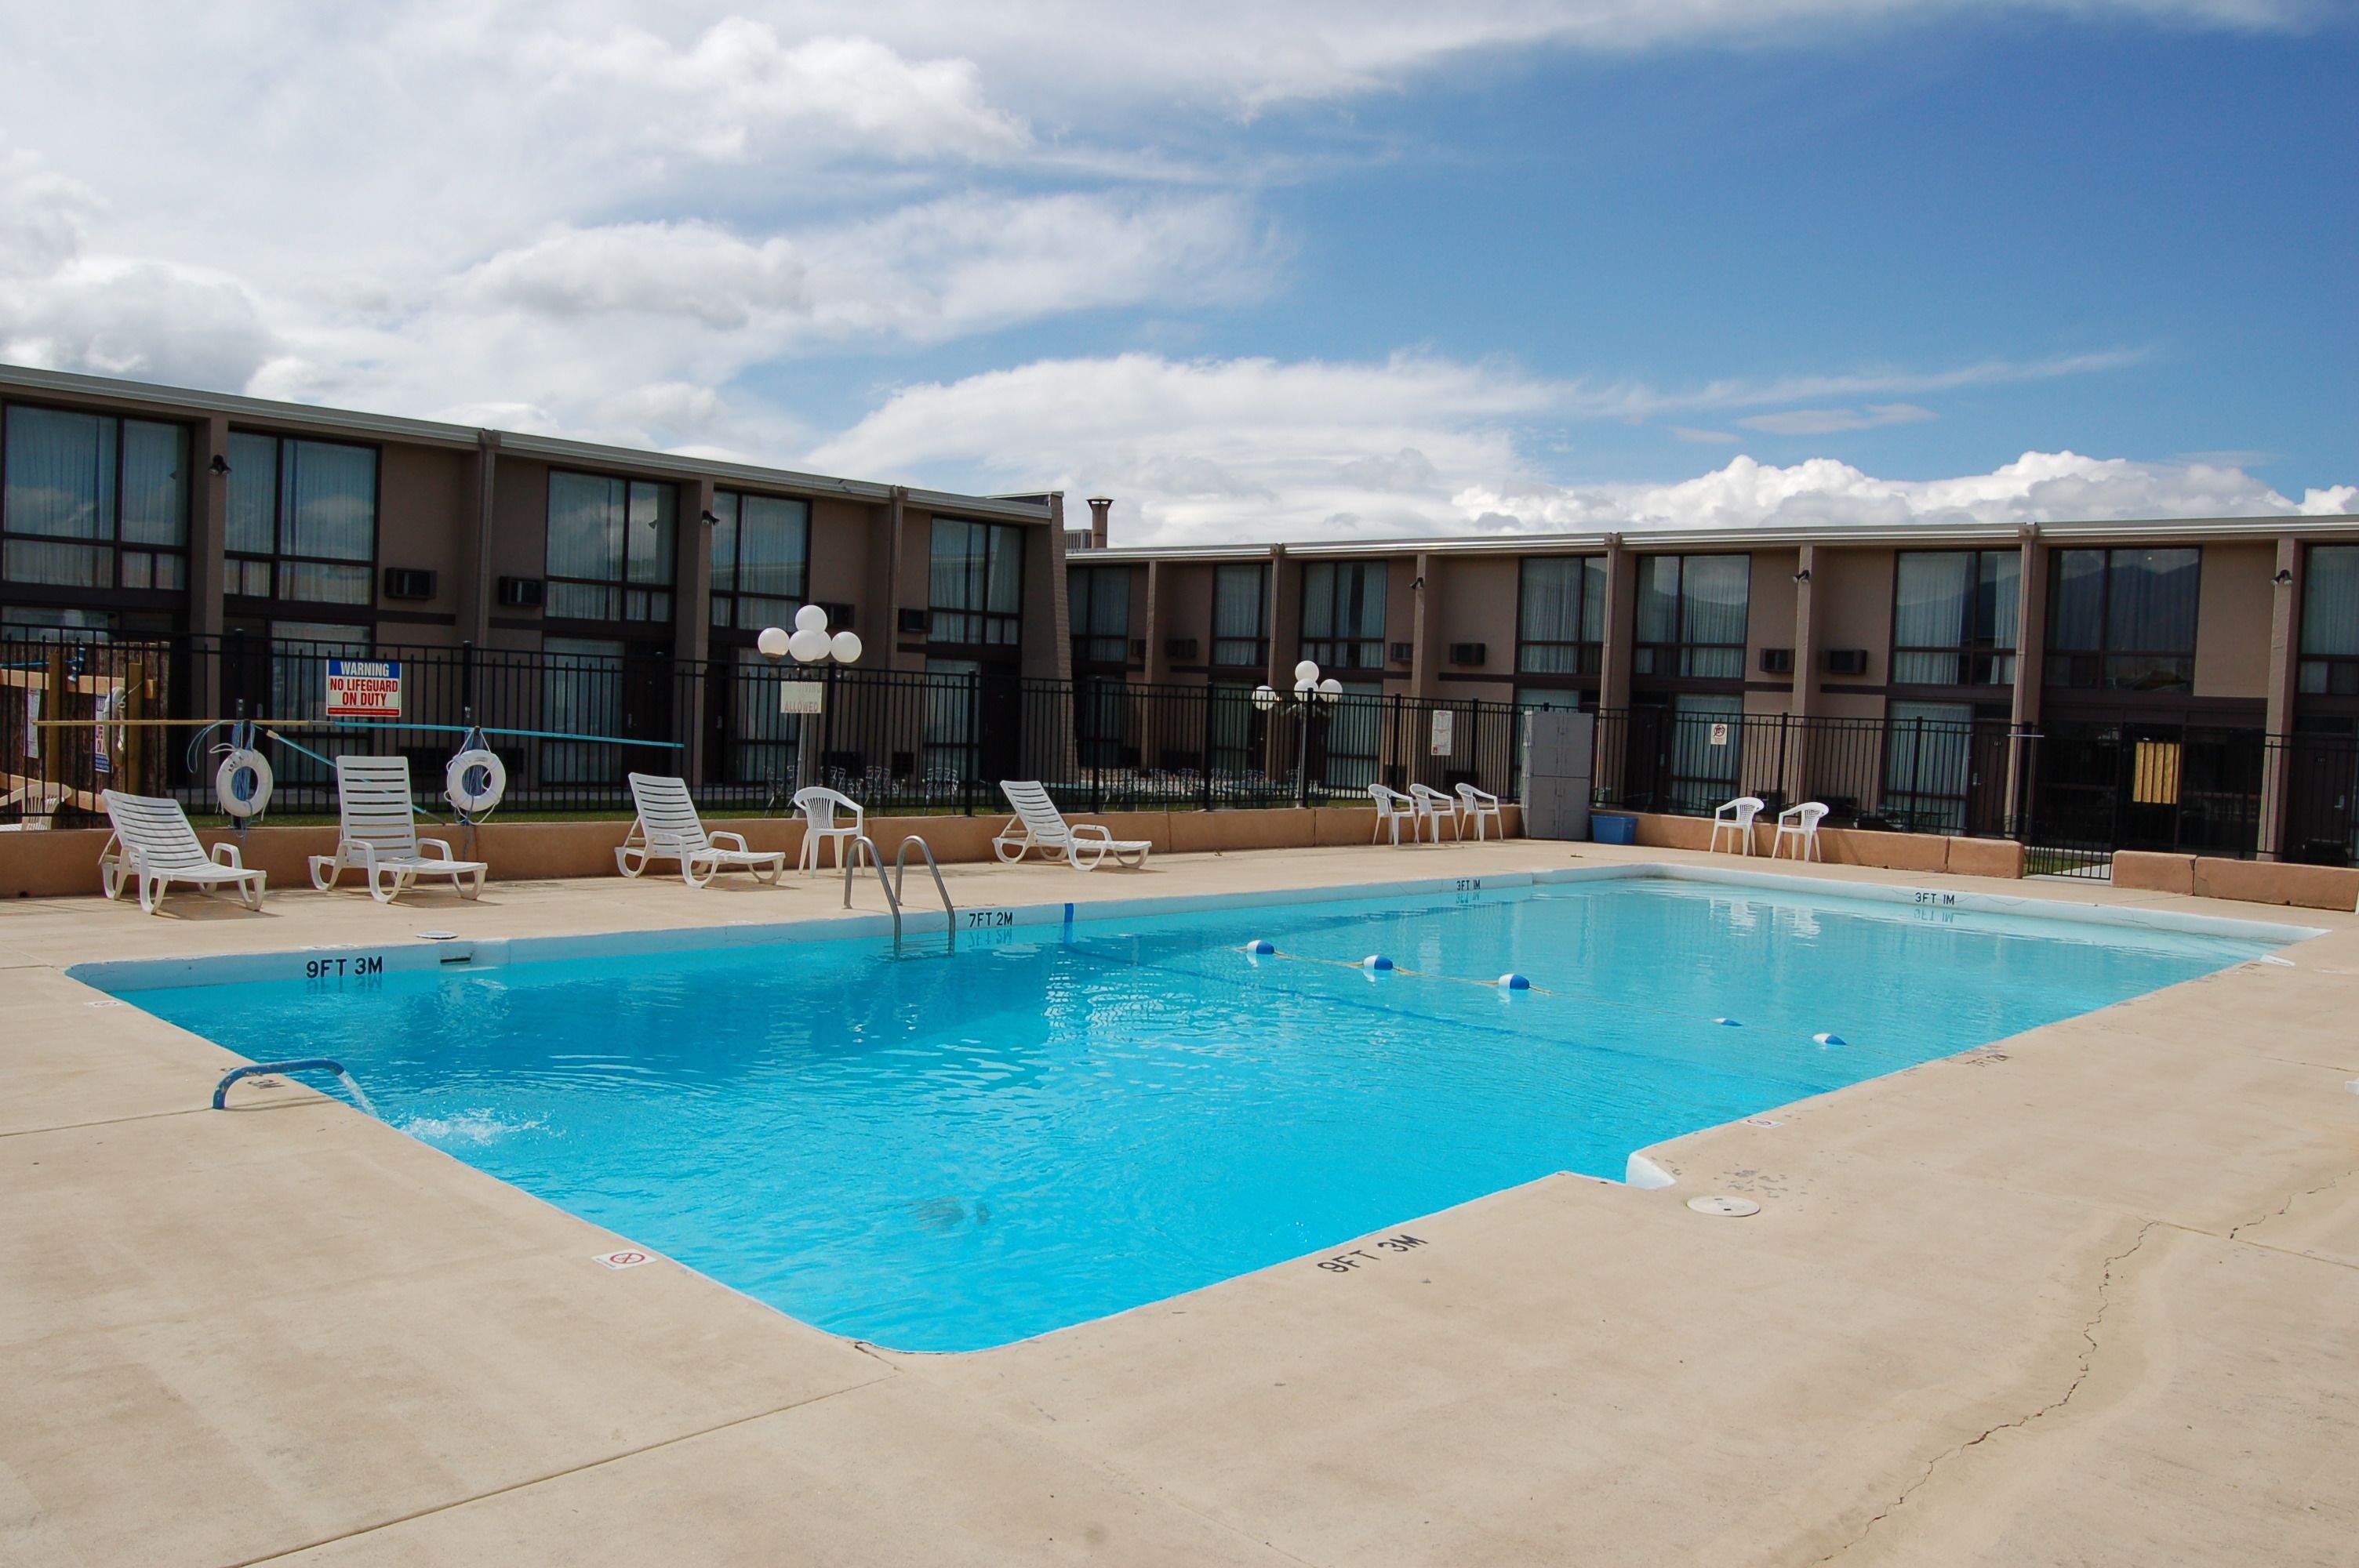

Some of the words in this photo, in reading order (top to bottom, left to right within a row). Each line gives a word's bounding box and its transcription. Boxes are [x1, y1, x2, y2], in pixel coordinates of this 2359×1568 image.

[340, 661, 389, 677] WARNING
[330, 678, 343, 691] NO
[347, 679, 398, 692] LIFEGUARD
[343, 691, 357, 706] ON
[361, 692, 387, 706] DUTY
[784, 702, 819, 713] ALLOWED
[1456, 880, 1470, 891] 3FT
[1915, 892, 1937, 904] 3FT
[969, 912, 993, 927] 7FT
[996, 911, 1013, 926] 2M
[306, 958, 347, 979] 9FT
[354, 956, 383, 975] 3M
[1317, 1250, 1381, 1273] 9FT
[1377, 1234, 1429, 1252] 3M
